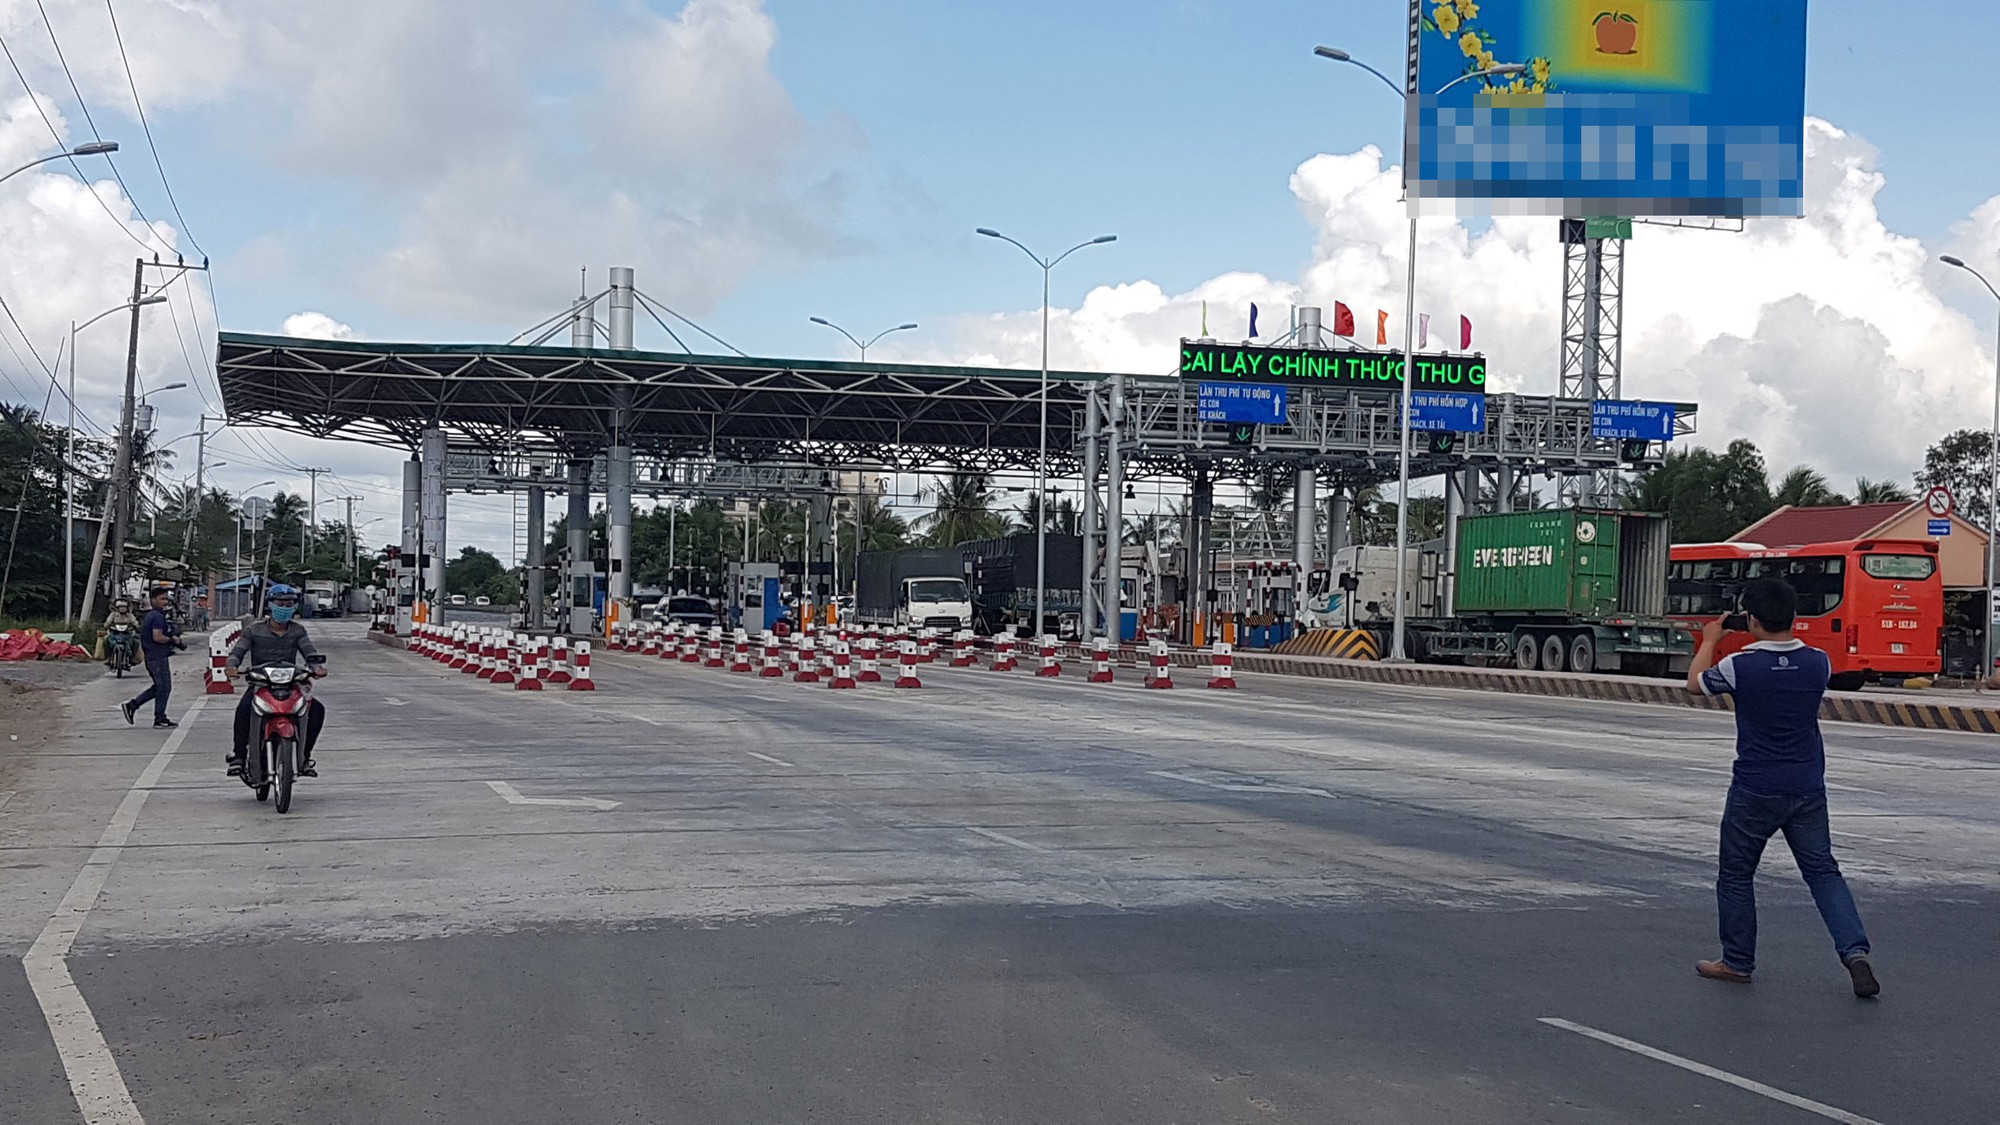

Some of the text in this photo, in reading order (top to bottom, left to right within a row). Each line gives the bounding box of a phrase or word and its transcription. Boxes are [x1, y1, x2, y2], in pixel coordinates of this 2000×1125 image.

[1220, 352, 1262, 377] LẬY
[1268, 353, 1338, 378] CHÍNH
[1416, 362, 1462, 384] THU
[1468, 365, 1484, 385] G
[1200, 384, 1213, 396] LÀN
[1214, 386, 1227, 397] THU
[1228, 385, 1240, 398] PHÍ
[1242, 387, 1251, 400] TỰ
[1200, 399, 1220, 408] XE CON
[1415, 396, 1427, 406] THU
[1428, 395, 1439, 407] PHÍ
[1199, 410, 1207, 419] XE
[1593, 402, 1606, 414] LÀN
[1607, 405, 1619, 415] THU
[1620, 404, 1631, 416] PHÍ
[1473, 545, 1553, 568] EVERGREEN
